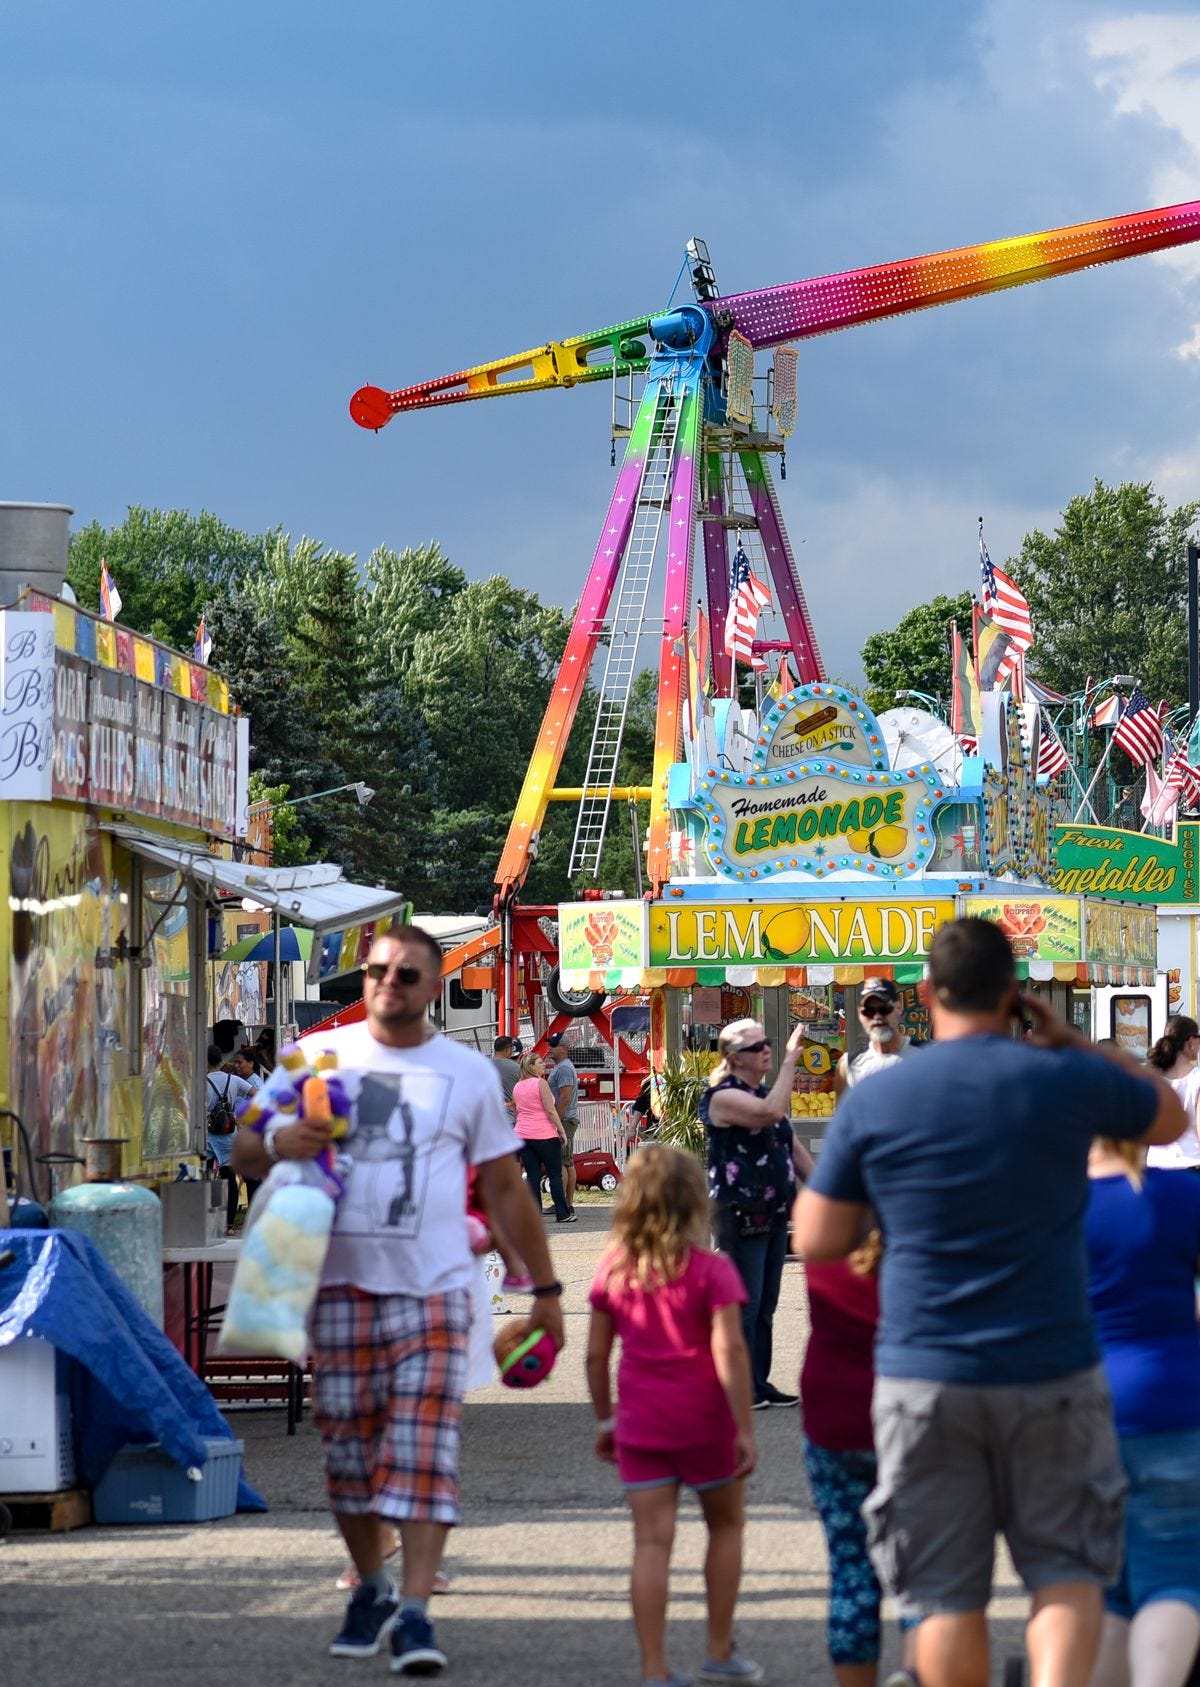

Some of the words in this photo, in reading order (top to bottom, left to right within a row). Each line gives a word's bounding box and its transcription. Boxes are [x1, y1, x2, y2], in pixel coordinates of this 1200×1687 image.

[90, 721, 134, 797] CHIPS
[771, 741, 805, 759] CHEESE
[806, 736, 820, 749] ON
[819, 733, 828, 745] A
[828, 724, 857, 741] STICK
[731, 785, 828, 818] Homemade
[734, 791, 905, 854] LEMONADE
[1056, 830, 1125, 852] Fresh
[1053, 856, 1178, 895] egetables
[1182, 829, 1195, 899] VEGGIES
[721, 985, 743, 997] MBO
[809, 1049, 823, 1068] 2
